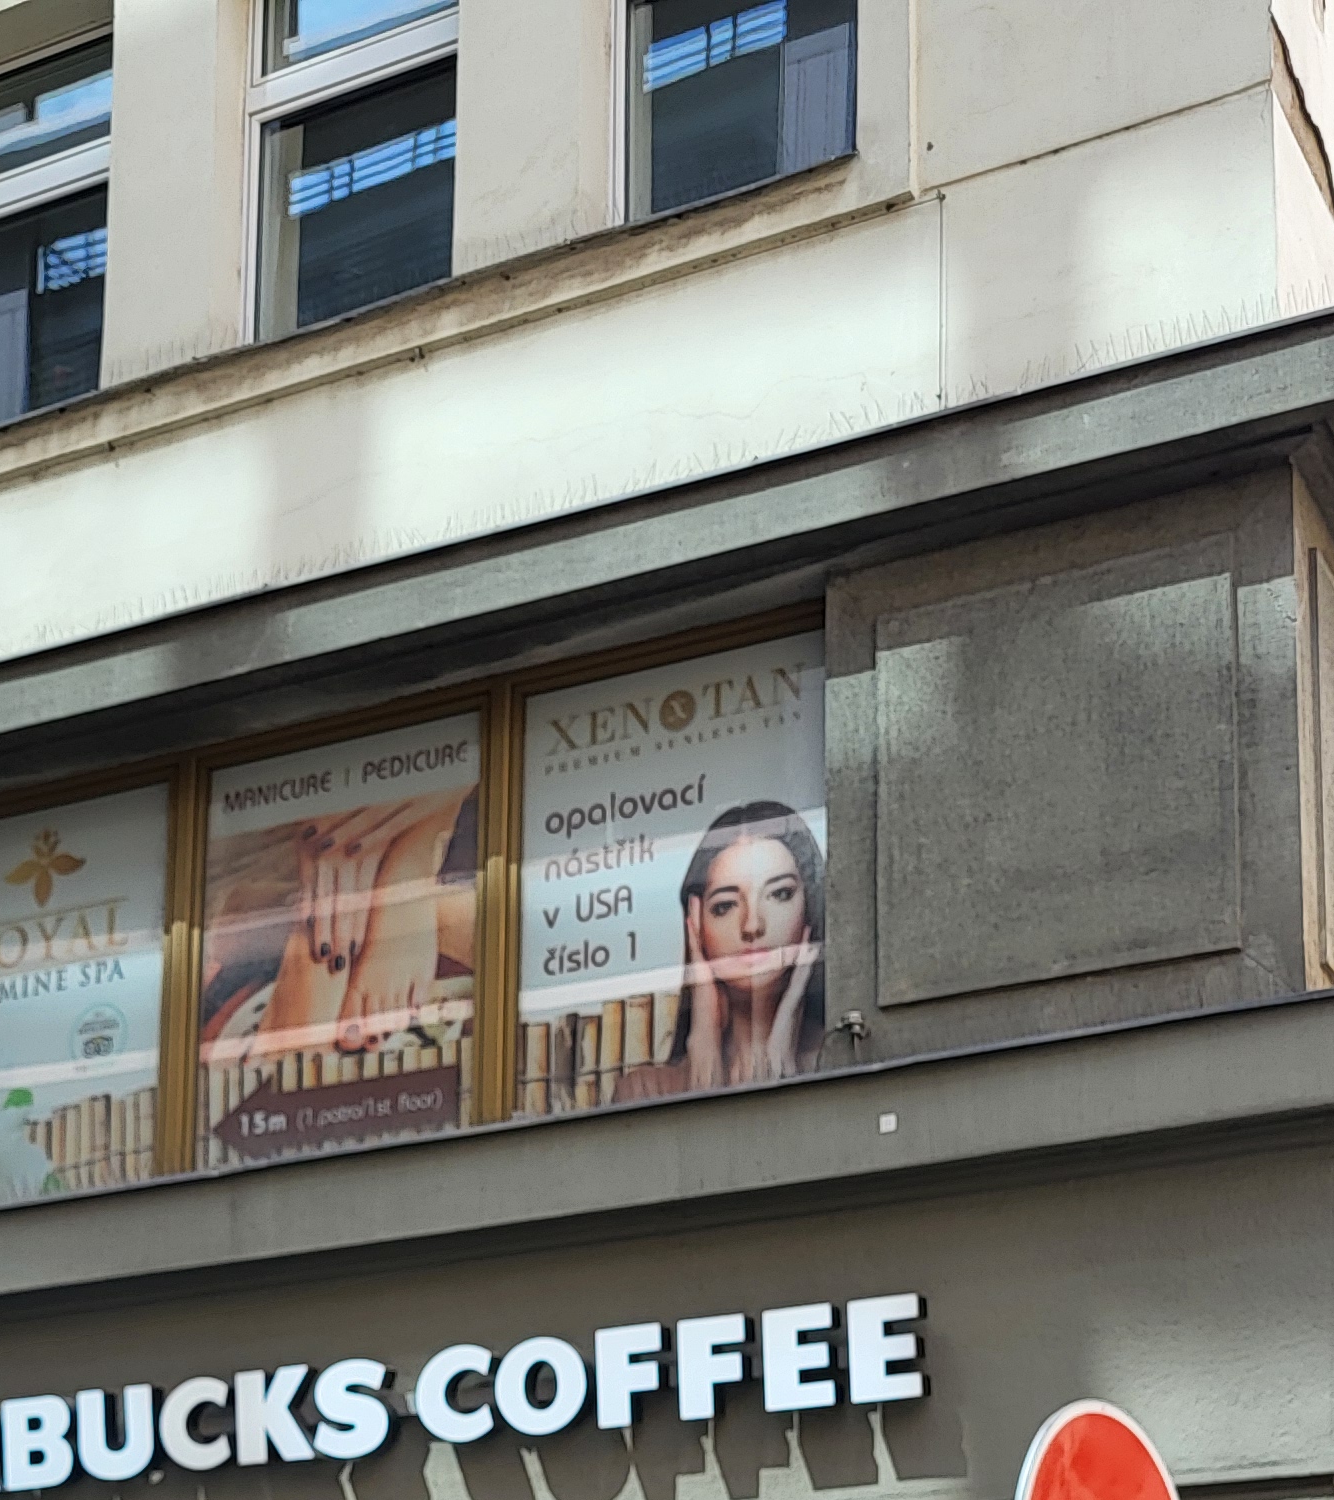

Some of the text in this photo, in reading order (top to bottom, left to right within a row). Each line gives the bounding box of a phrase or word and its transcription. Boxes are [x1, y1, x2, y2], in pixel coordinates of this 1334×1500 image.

[222, 769, 332, 815] MANICURE
[361, 740, 469, 785] PEDICURE
[544, 773, 707, 840] opalovací
[543, 833, 655, 882] nástřik
[543, 885, 634, 930] v USA
[78, 956, 126, 988] SPA
[543, 930, 637, 976] číslo 1
[414, 1292, 925, 1444] COFFEE
